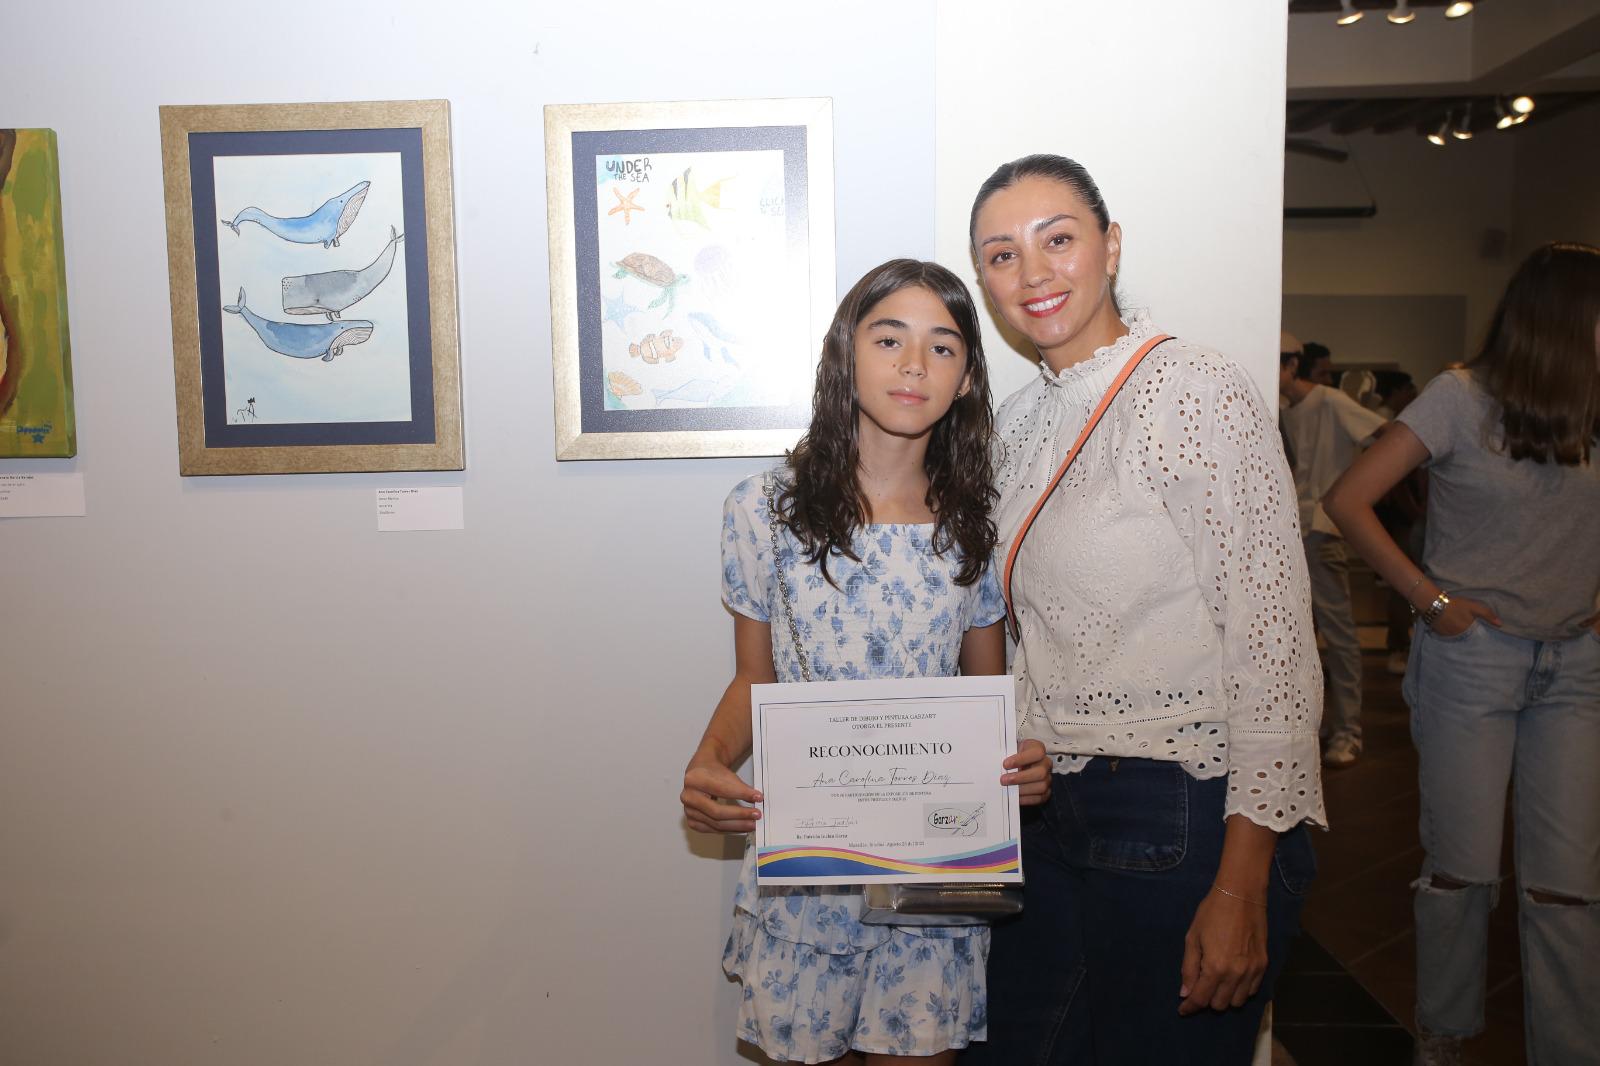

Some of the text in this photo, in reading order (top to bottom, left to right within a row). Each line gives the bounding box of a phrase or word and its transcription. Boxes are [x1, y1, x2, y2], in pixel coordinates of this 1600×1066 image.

[605, 157, 653, 174] UNDER
[614, 172, 650, 183] THE SEA
[808, 741, 953, 759] RECONOCIMIENTO
[813, 772, 836, 788] Ana
[838, 769, 886, 789] Carolina
[888, 767, 918, 786] Torres
